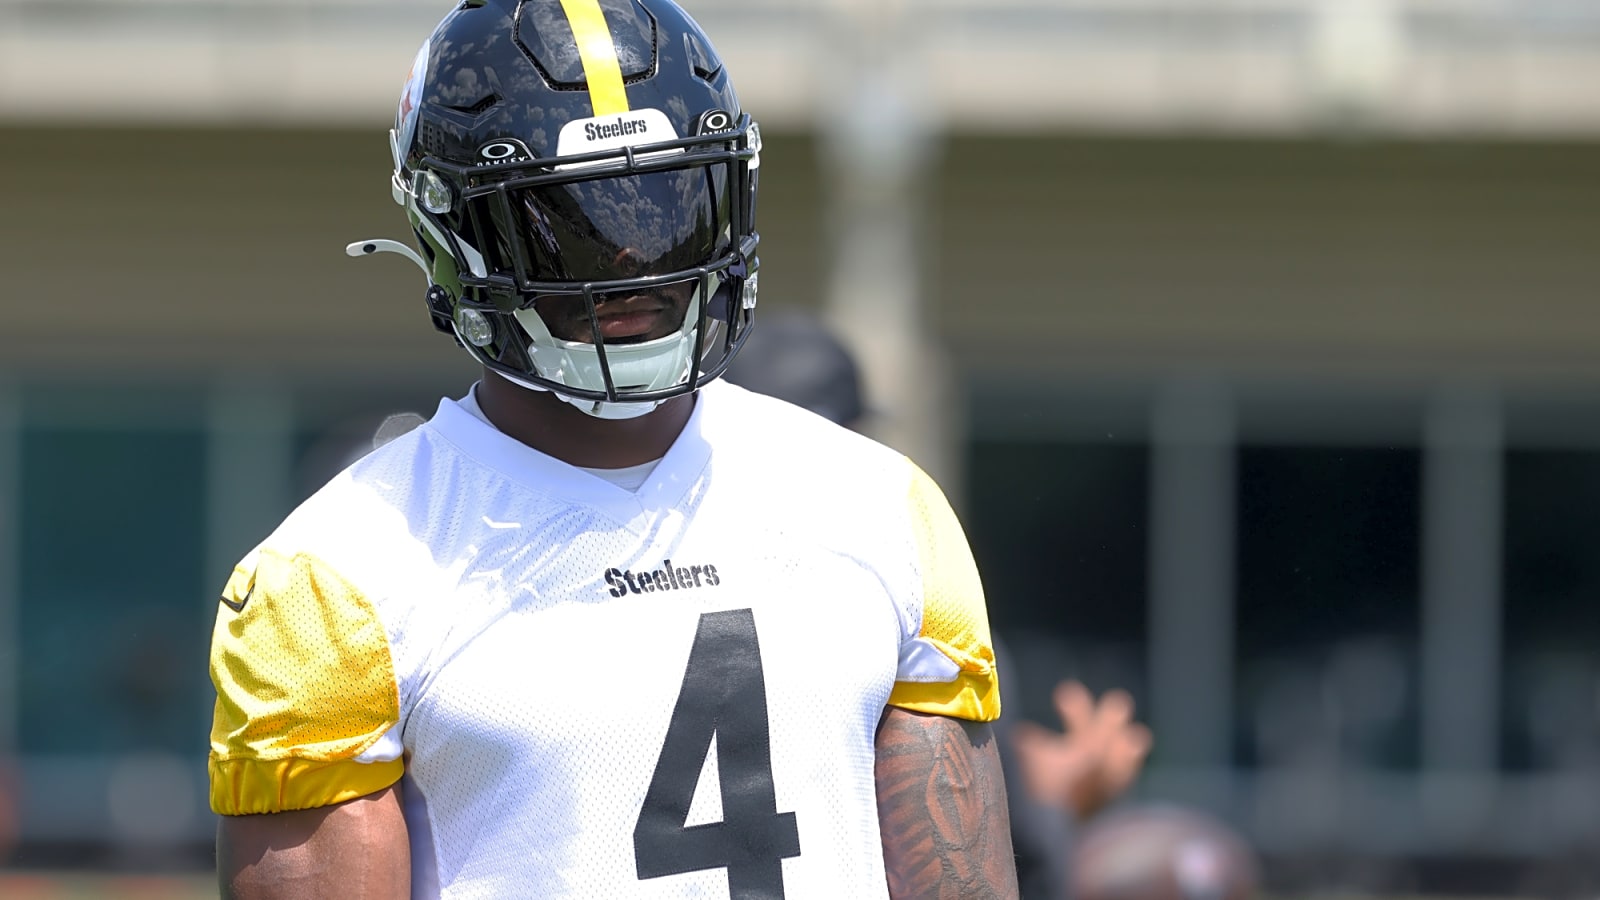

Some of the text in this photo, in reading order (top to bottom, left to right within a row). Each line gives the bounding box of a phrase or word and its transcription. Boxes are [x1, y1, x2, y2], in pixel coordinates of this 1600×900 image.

[584, 117, 647, 141] Steelers
[604, 559, 720, 598] Steelers
[633, 607, 801, 900] 4
